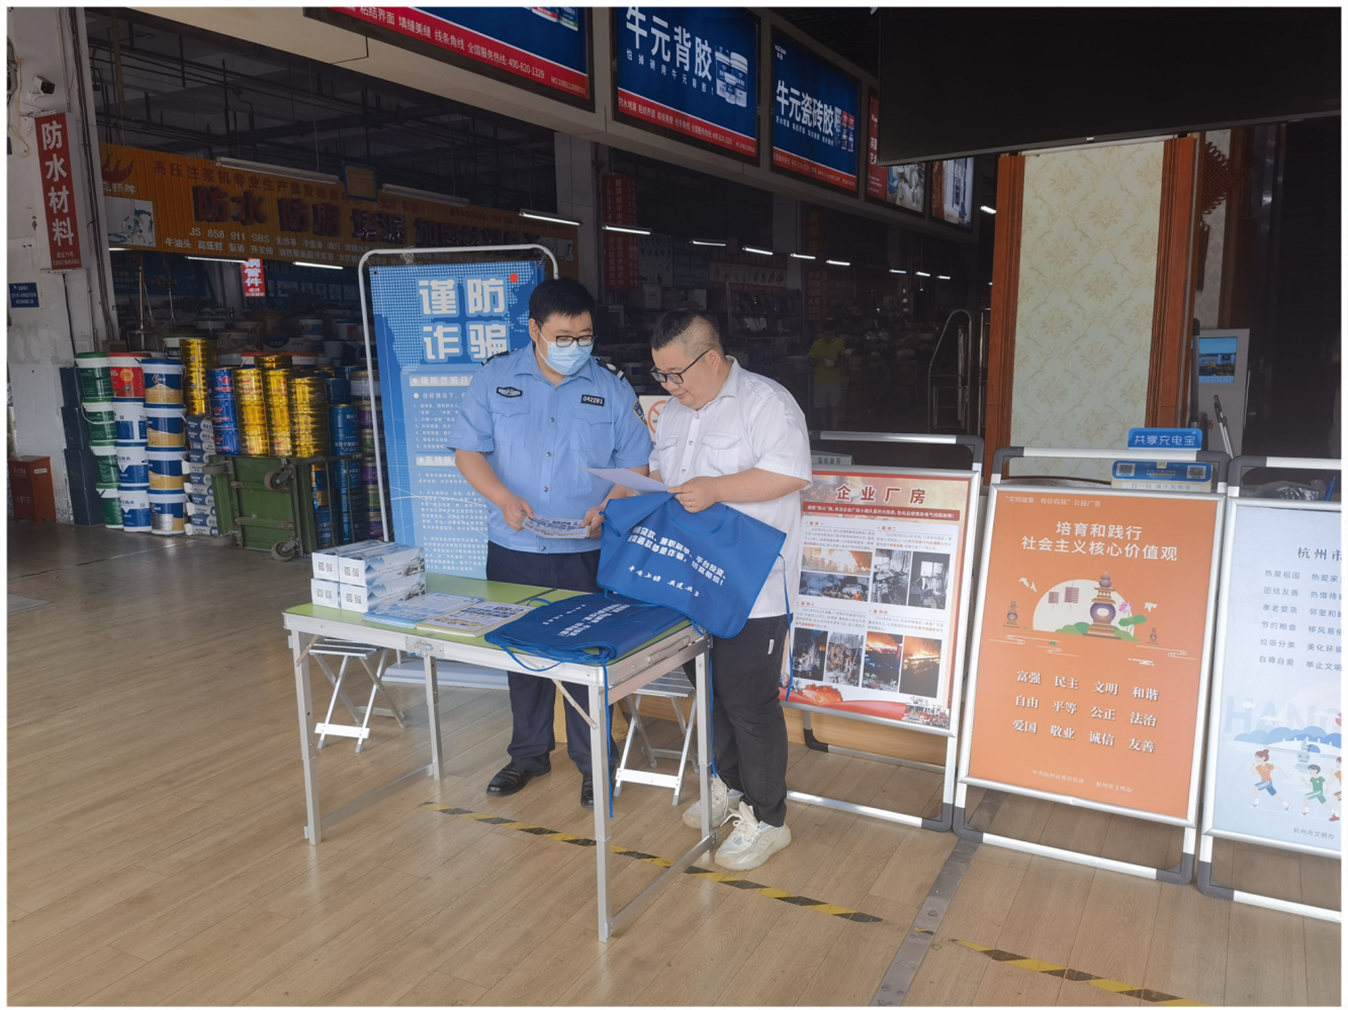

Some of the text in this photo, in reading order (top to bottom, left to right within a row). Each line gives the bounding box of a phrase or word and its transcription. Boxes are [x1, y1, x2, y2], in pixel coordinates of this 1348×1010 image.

[626, 7, 713, 81] 牛元背胶
[776, 80, 833, 136] 牛元瓷砖胶
[41, 120, 75, 247] 防水材料
[192, 186, 268, 226] 防水
[418, 278, 505, 315] 谨防
[422, 322, 508, 361] 诈骗
[1134, 434, 1196, 447] 共享充电宝
[836, 485, 926, 504] 企业厂房
[1056, 520, 1143, 541] 培育和践行
[1021, 535, 1178, 562] 社会主义核心价值观
[1264, 569, 1342, 583] 热爱祖国 热爱家
[1260, 638, 1296, 649] 垃圾分类
[1017, 670, 1159, 701] 富强 民主 文明 和谐
[1015, 695, 1157, 727] 自由 平等 公正 法治
[1013, 719, 1155, 753] 爱国 敬业 诚信 友善
